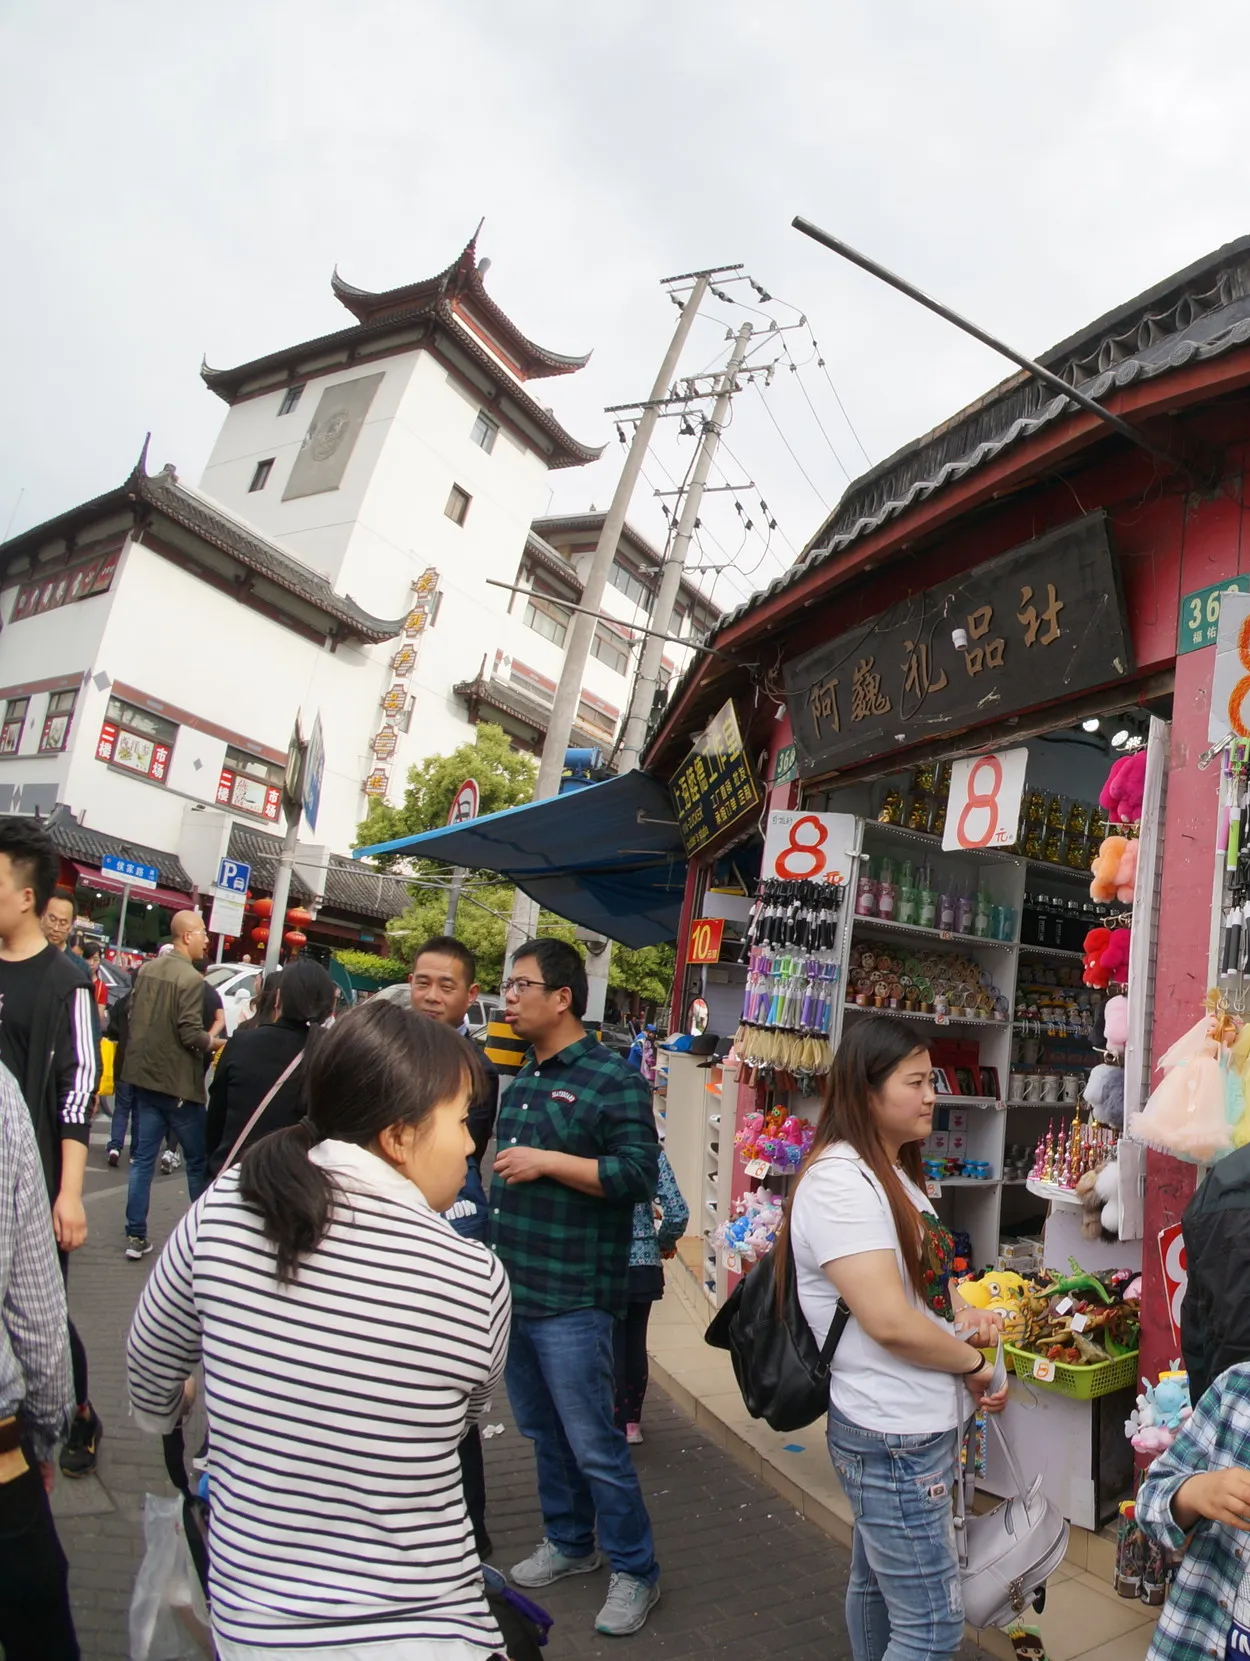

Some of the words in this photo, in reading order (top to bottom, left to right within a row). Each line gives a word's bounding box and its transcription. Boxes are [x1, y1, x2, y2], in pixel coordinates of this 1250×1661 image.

[1188, 584, 1239, 629] 36
[151, 747, 168, 780] 市场
[265, 789, 280, 819] 市场
[220, 861, 238, 888] P
